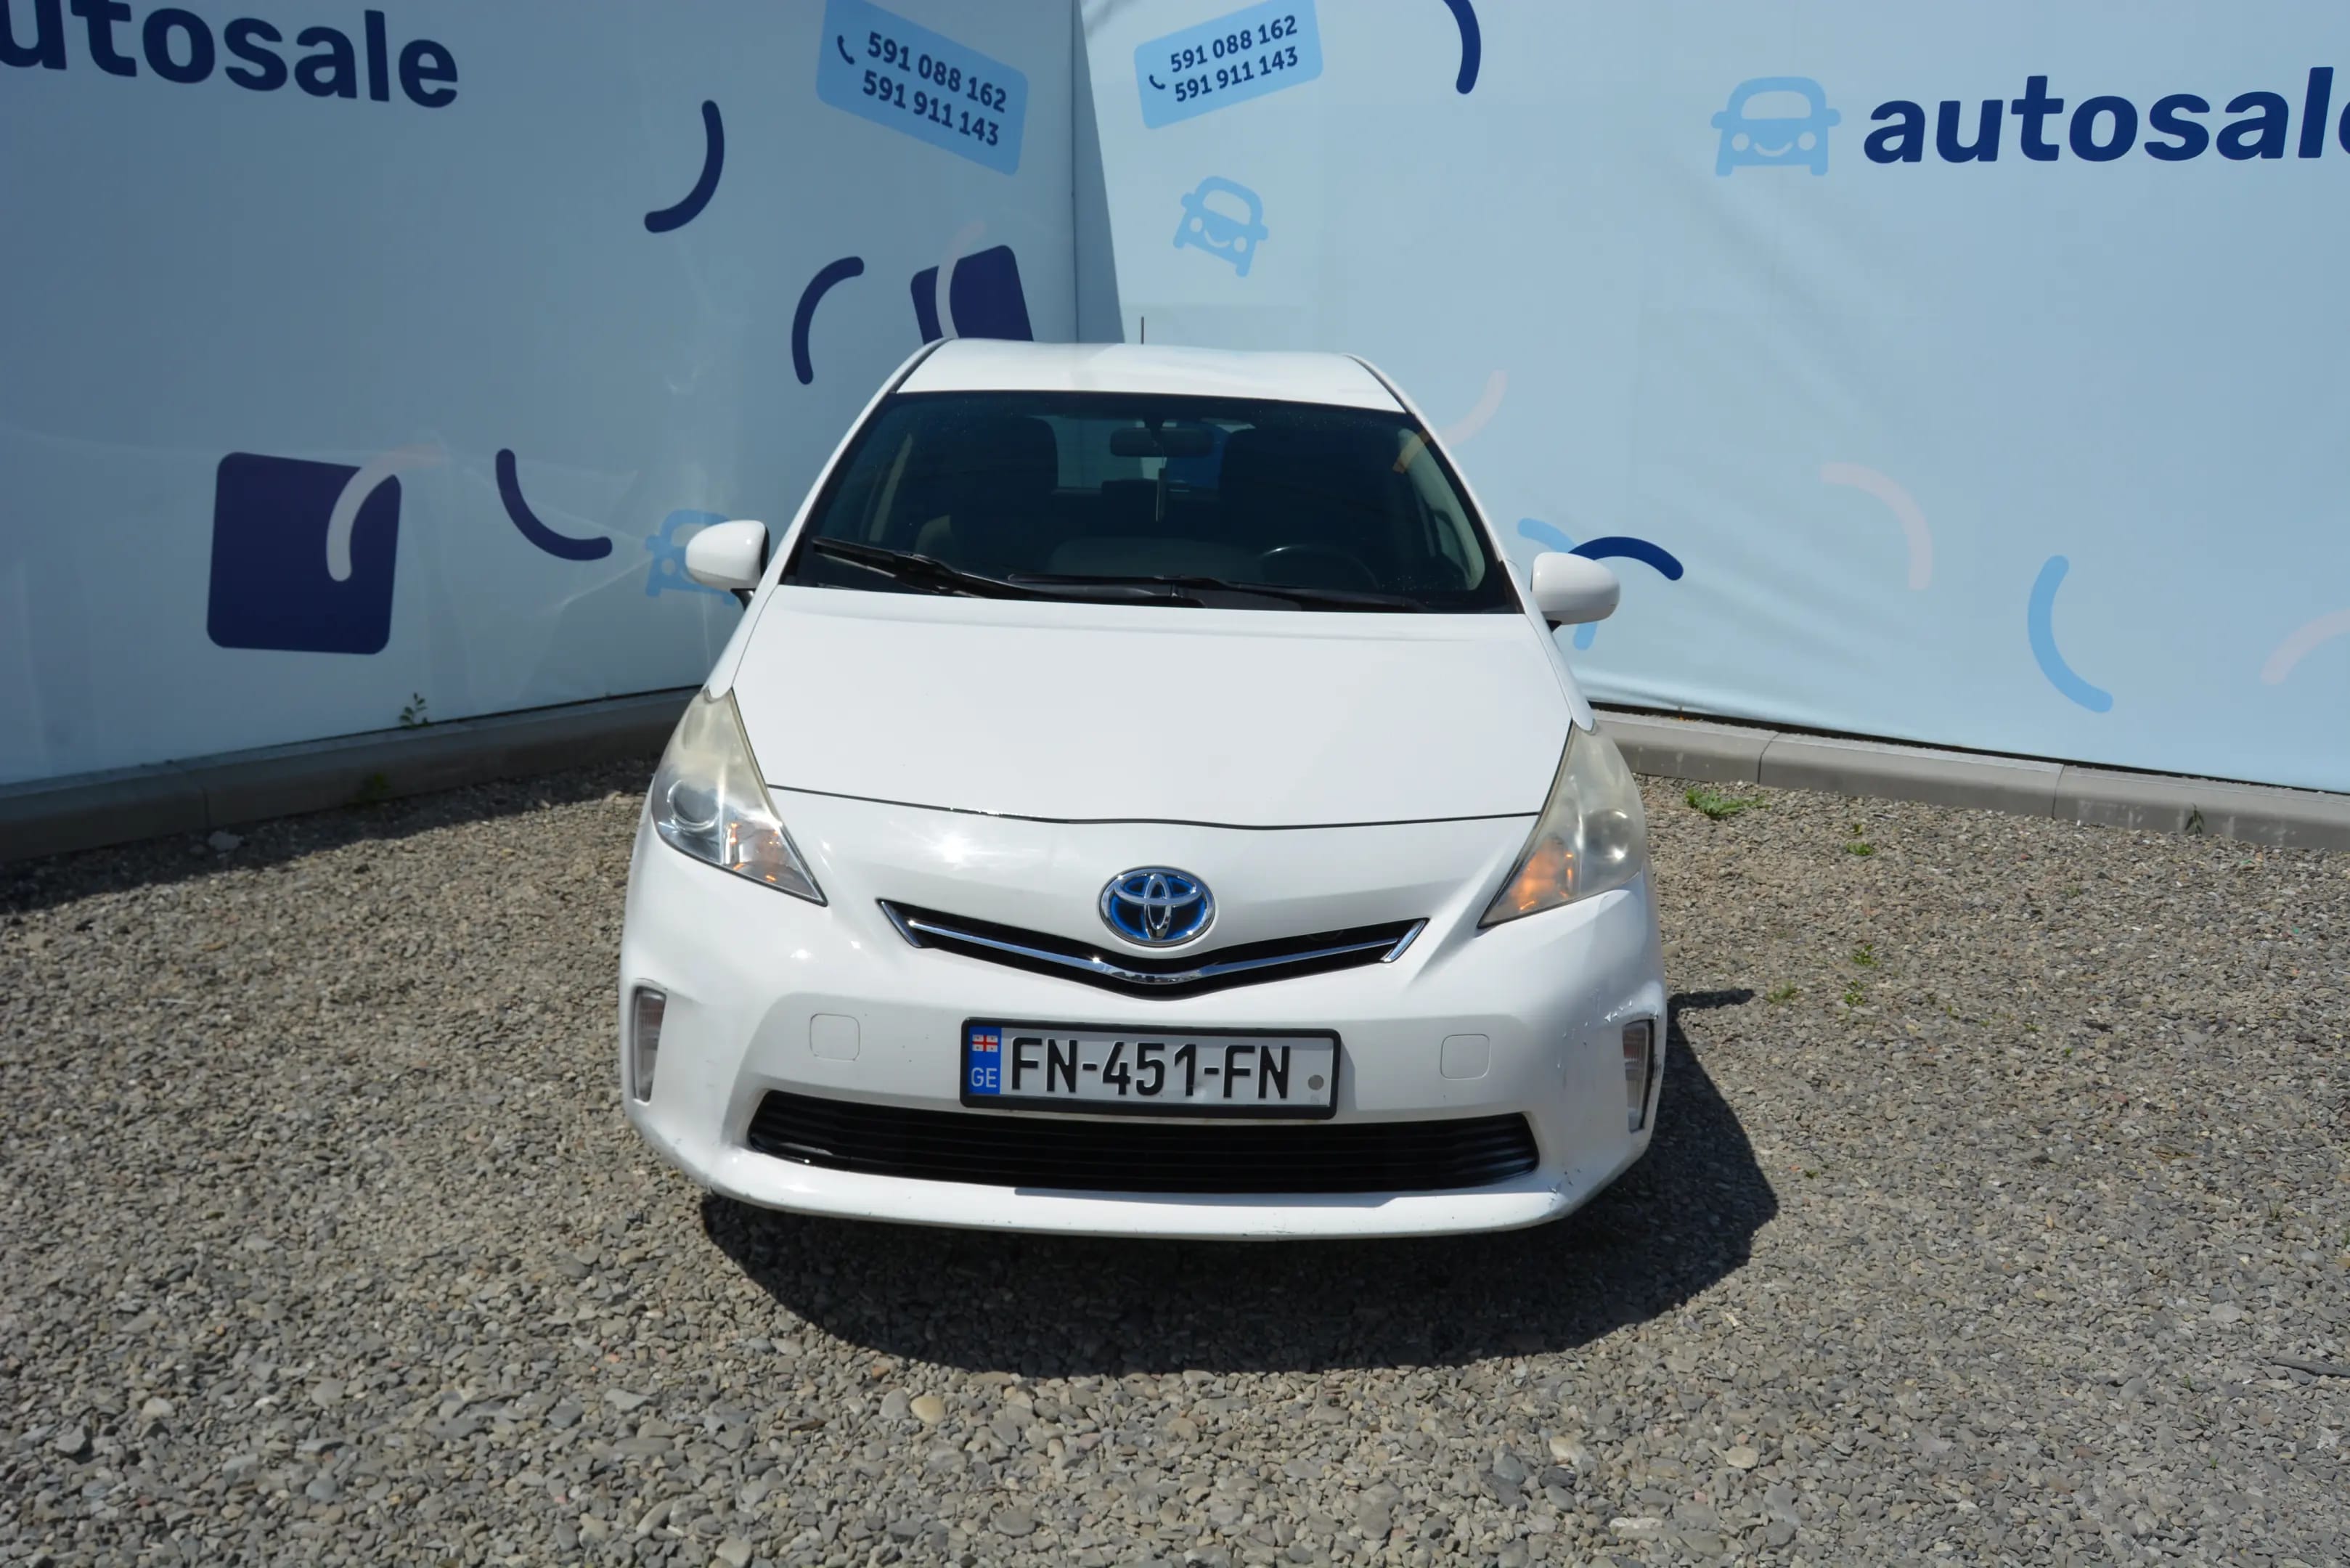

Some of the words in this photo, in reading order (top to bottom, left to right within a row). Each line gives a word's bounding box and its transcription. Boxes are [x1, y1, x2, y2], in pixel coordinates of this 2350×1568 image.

[867, 30, 911, 73] 591
[918, 54, 962, 93] 088
[966, 76, 1007, 114] 162
[1170, 44, 1208, 73] 591
[1212, 29, 1252, 59] 088
[1257, 15, 1298, 45] 162
[1175, 74, 1212, 102] 591
[1216, 61, 1254, 89] 911
[1259, 46, 1298, 76] 143
[862, 69, 907, 110] 591
[913, 91, 953, 128] 911
[958, 110, 1000, 147] 143
[1864, 66, 2350, 164] autosal
[971, 1066, 997, 1089] GE
[1011, 1037, 1291, 1099] FN-451-FN
